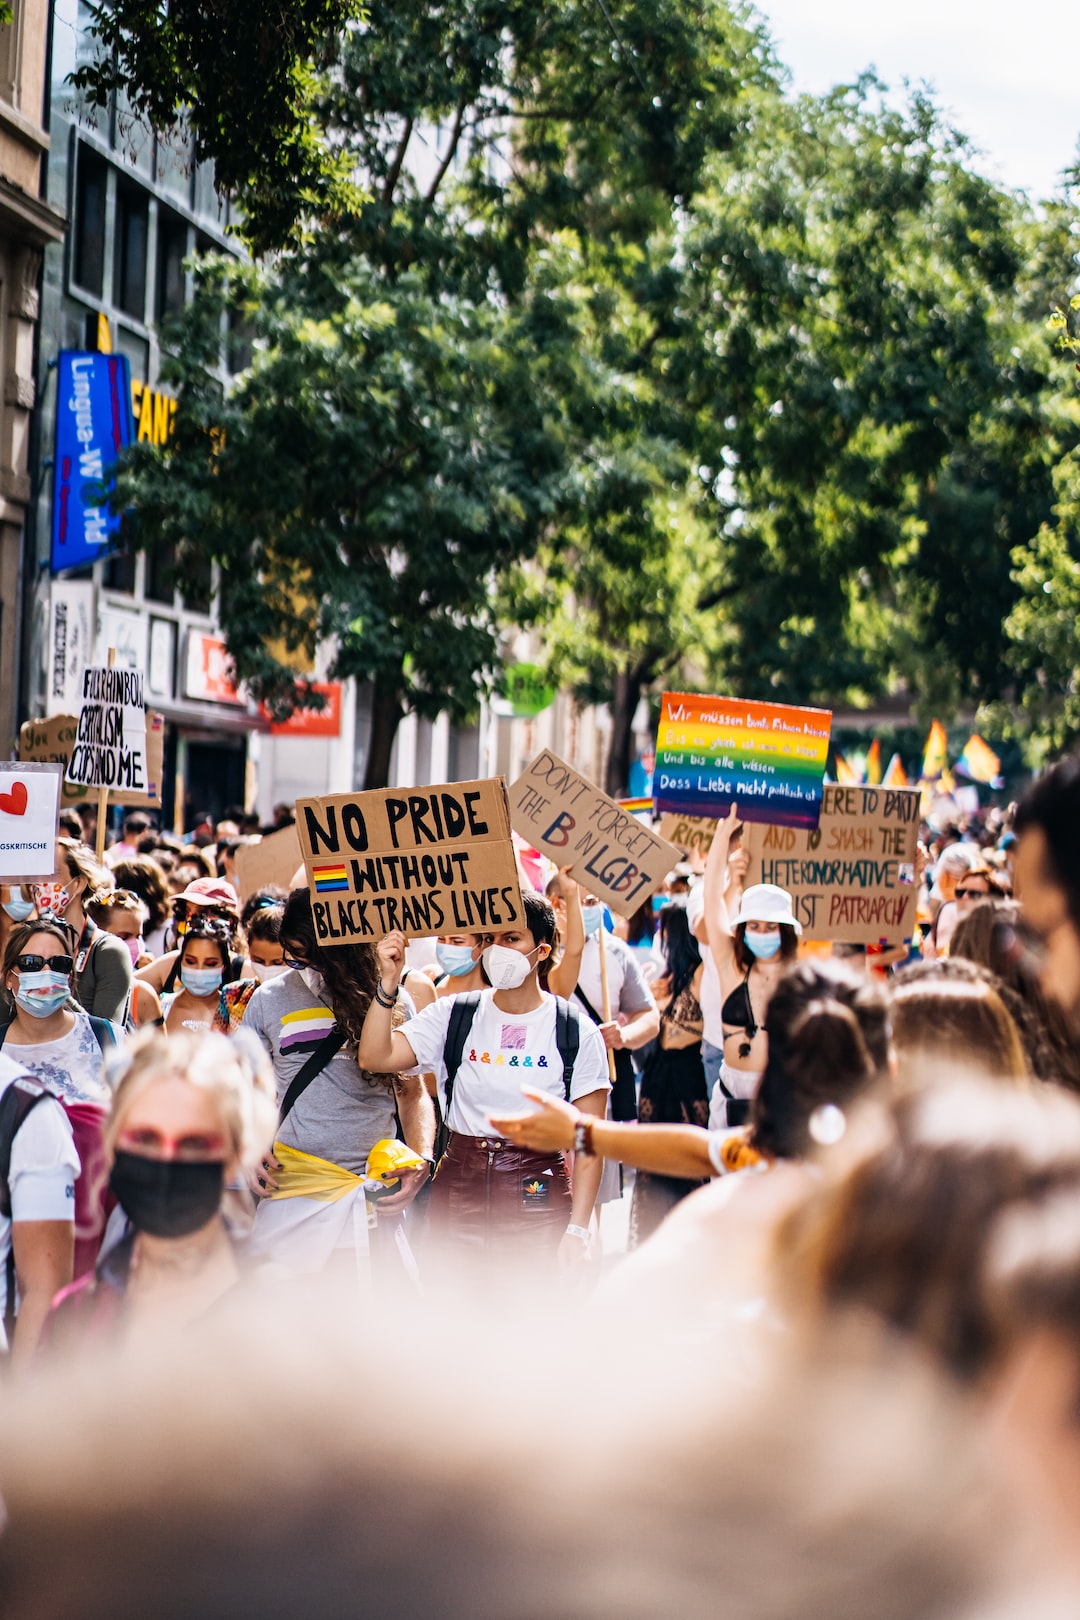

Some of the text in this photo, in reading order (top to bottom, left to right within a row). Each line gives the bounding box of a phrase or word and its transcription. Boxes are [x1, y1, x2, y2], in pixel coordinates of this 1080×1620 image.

[668, 703, 692, 722] Wir
[700, 711, 743, 726] müssen
[117, 750, 144, 788] ME
[663, 752, 776, 774] Und bis alle wissen
[660, 774, 691, 790] Dass
[697, 775, 732, 793] Liebe
[736, 778, 767, 796] nicht
[530, 753, 661, 860] DON'T FORGET
[820, 787, 857, 816] ERE
[860, 788, 879, 815] TO
[304, 791, 489, 855] NO PRIDE
[0, 842, 48, 850] GSKRITISCHE
[517, 785, 652, 902] THE B IN LGBT
[762, 825, 796, 851] AND
[826, 825, 874, 851] SMASH
[878, 827, 907, 855] THE
[350, 852, 470, 894] WITHOUT
[761, 858, 899, 888] HETERONORMATIVE
[312, 887, 518, 939] BLACK TRANS LIVES
